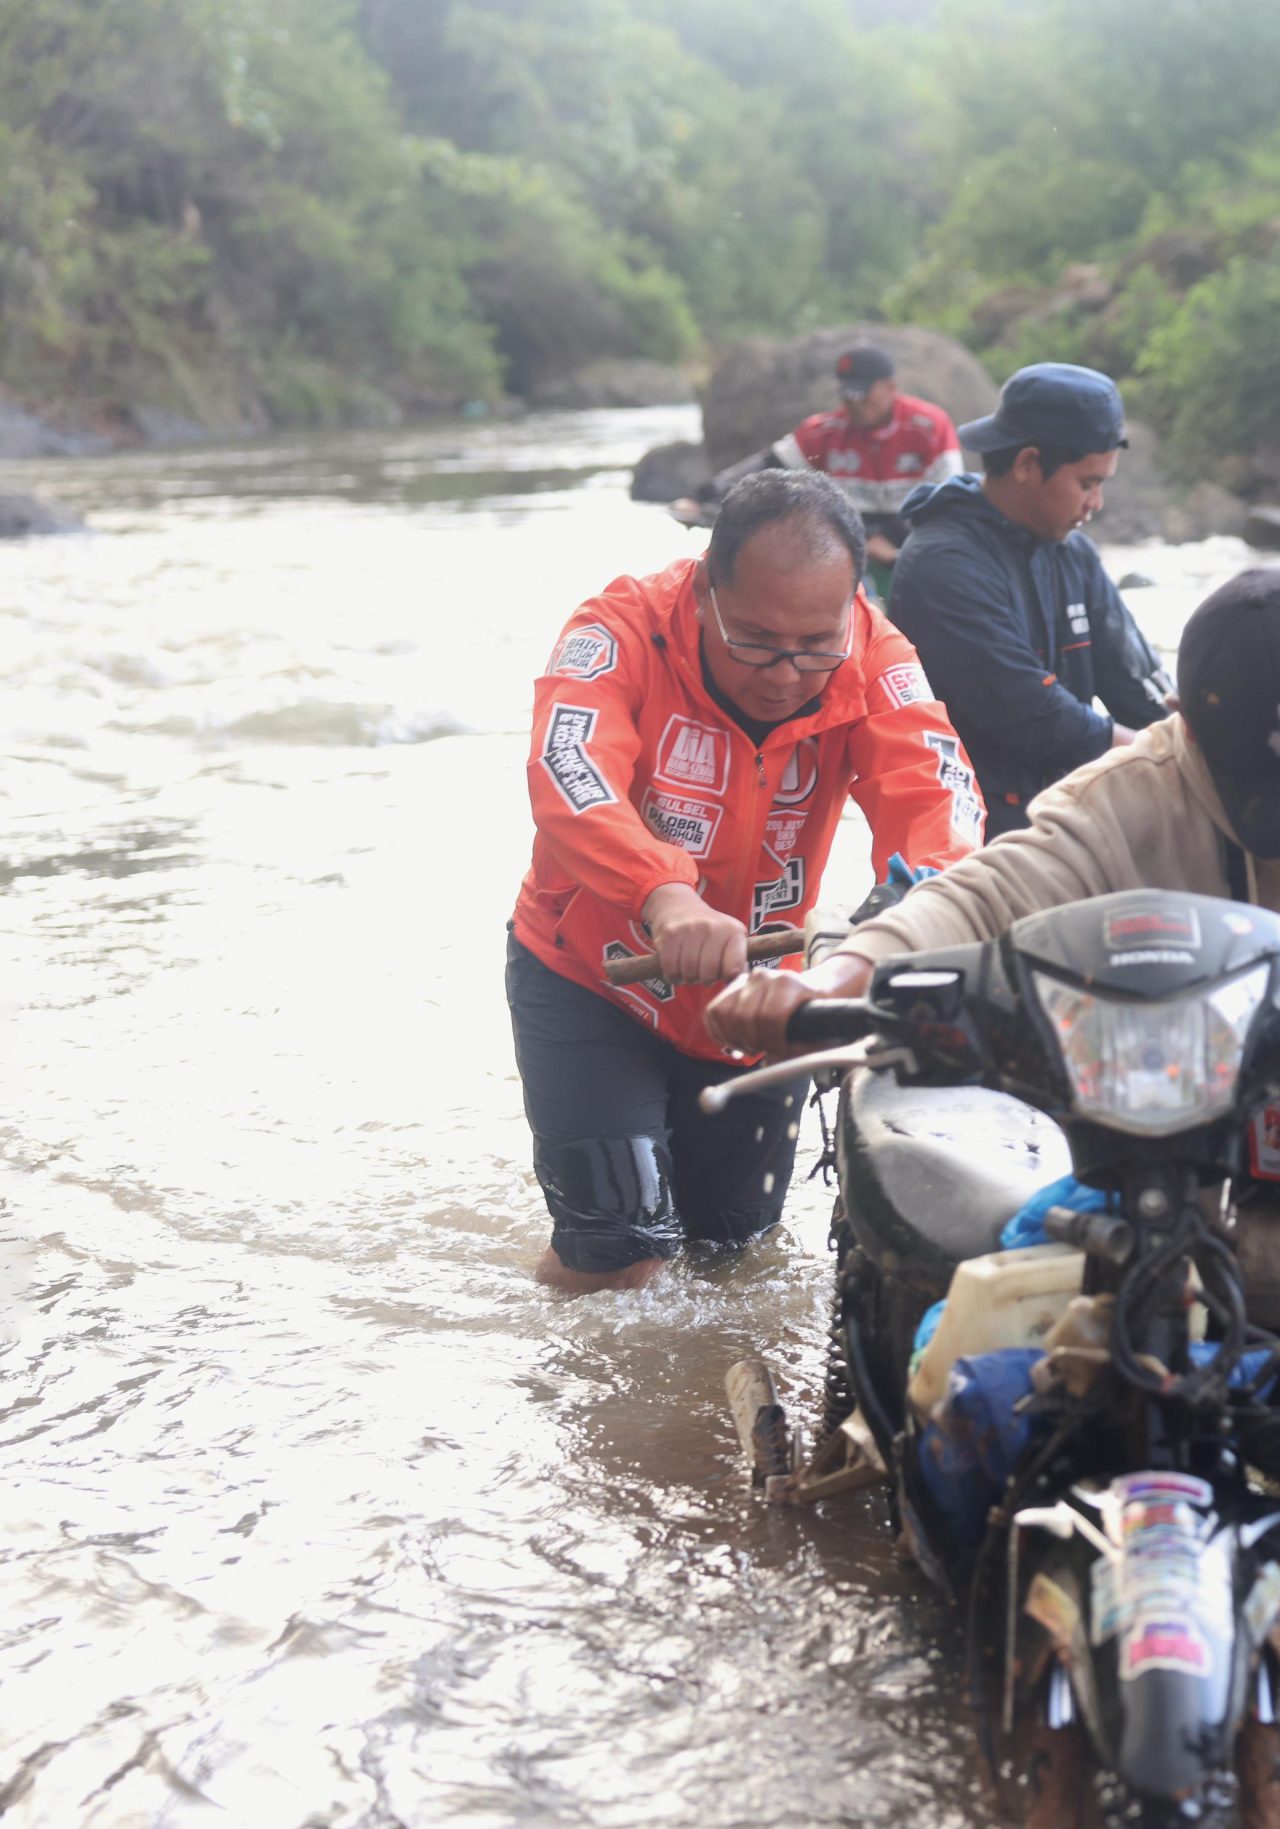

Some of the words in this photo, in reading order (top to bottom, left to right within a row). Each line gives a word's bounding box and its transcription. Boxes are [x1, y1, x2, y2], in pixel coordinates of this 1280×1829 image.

[566, 638, 604, 652] BAIK
[656, 797, 708, 818] SULSEL
[648, 807, 706, 835] GLOBAL
[1110, 950, 1195, 967] HONDA
